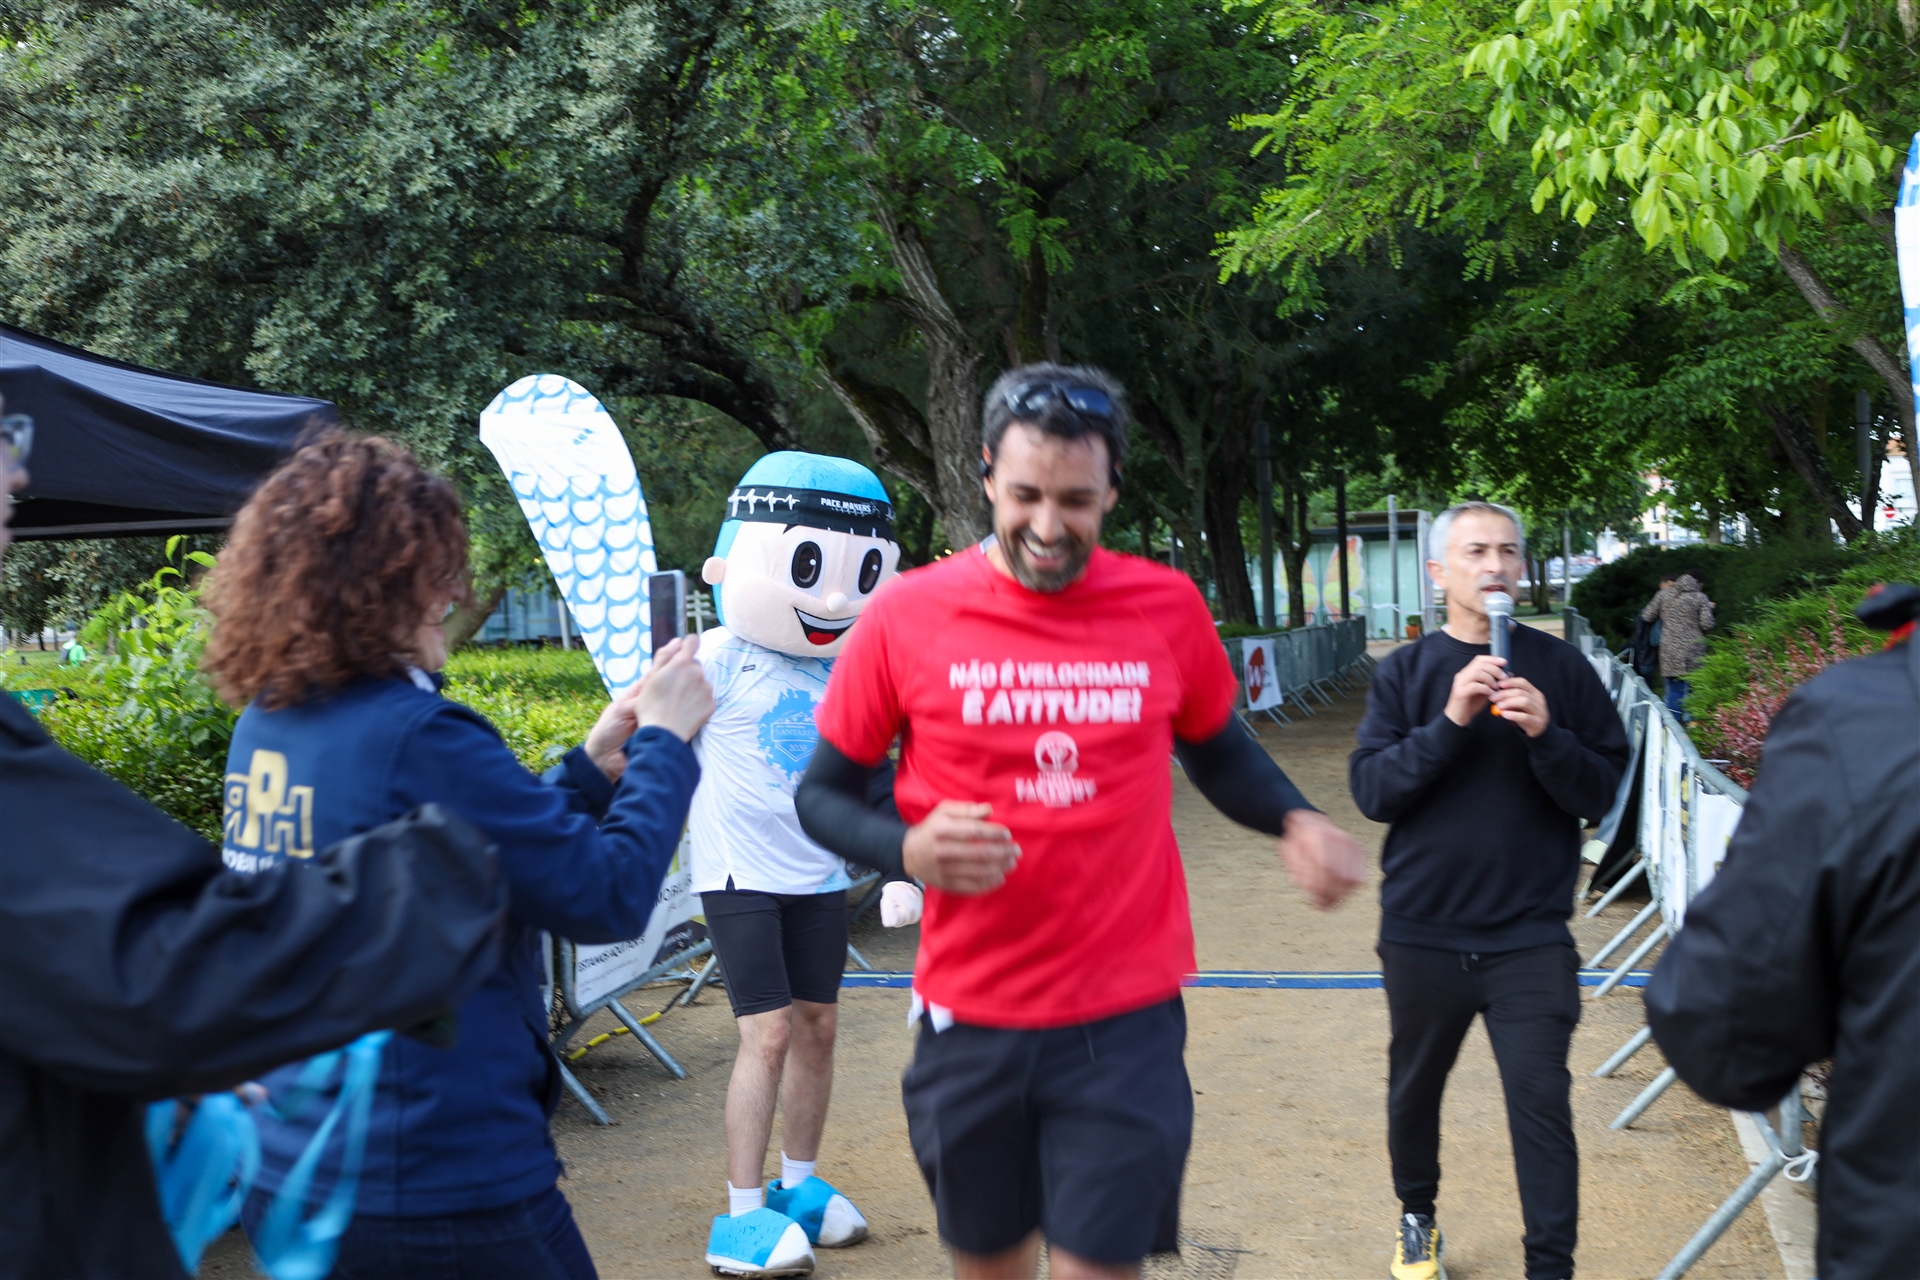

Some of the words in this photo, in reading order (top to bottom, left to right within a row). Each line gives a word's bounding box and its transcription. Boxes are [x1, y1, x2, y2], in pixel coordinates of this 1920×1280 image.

[821, 497, 841, 508] PACE
[842, 501, 871, 513] MAKERS
[950, 658, 997, 690] NÃO
[1000, 658, 1015, 688] É
[1017, 661, 1150, 688] VELOCIDADE
[987, 687, 1142, 725] ATITUDE!
